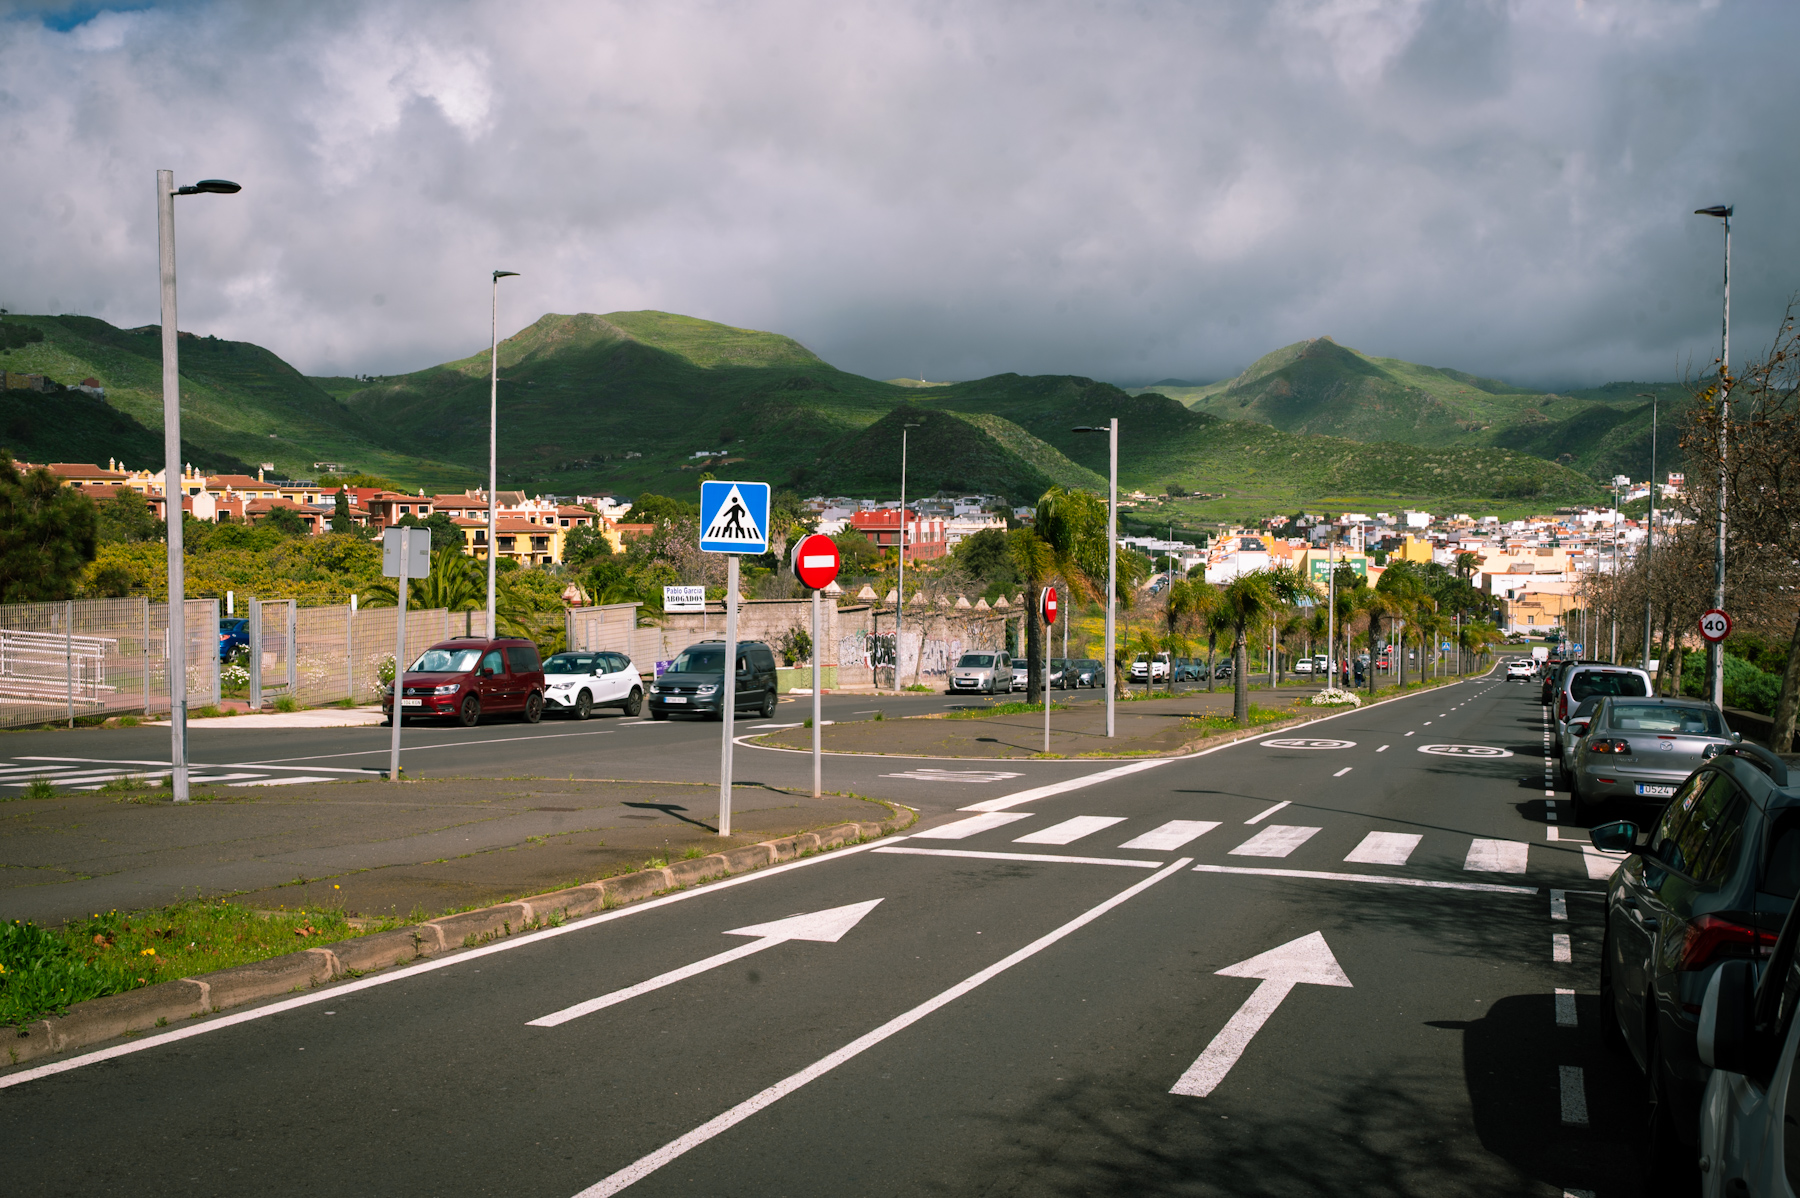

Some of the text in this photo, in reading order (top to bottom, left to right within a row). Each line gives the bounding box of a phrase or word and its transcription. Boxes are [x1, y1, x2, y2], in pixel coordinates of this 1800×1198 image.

[1704, 620, 1725, 632] 40
[1430, 747, 1498, 756] 40
[1645, 784, 1669, 794] 0524
